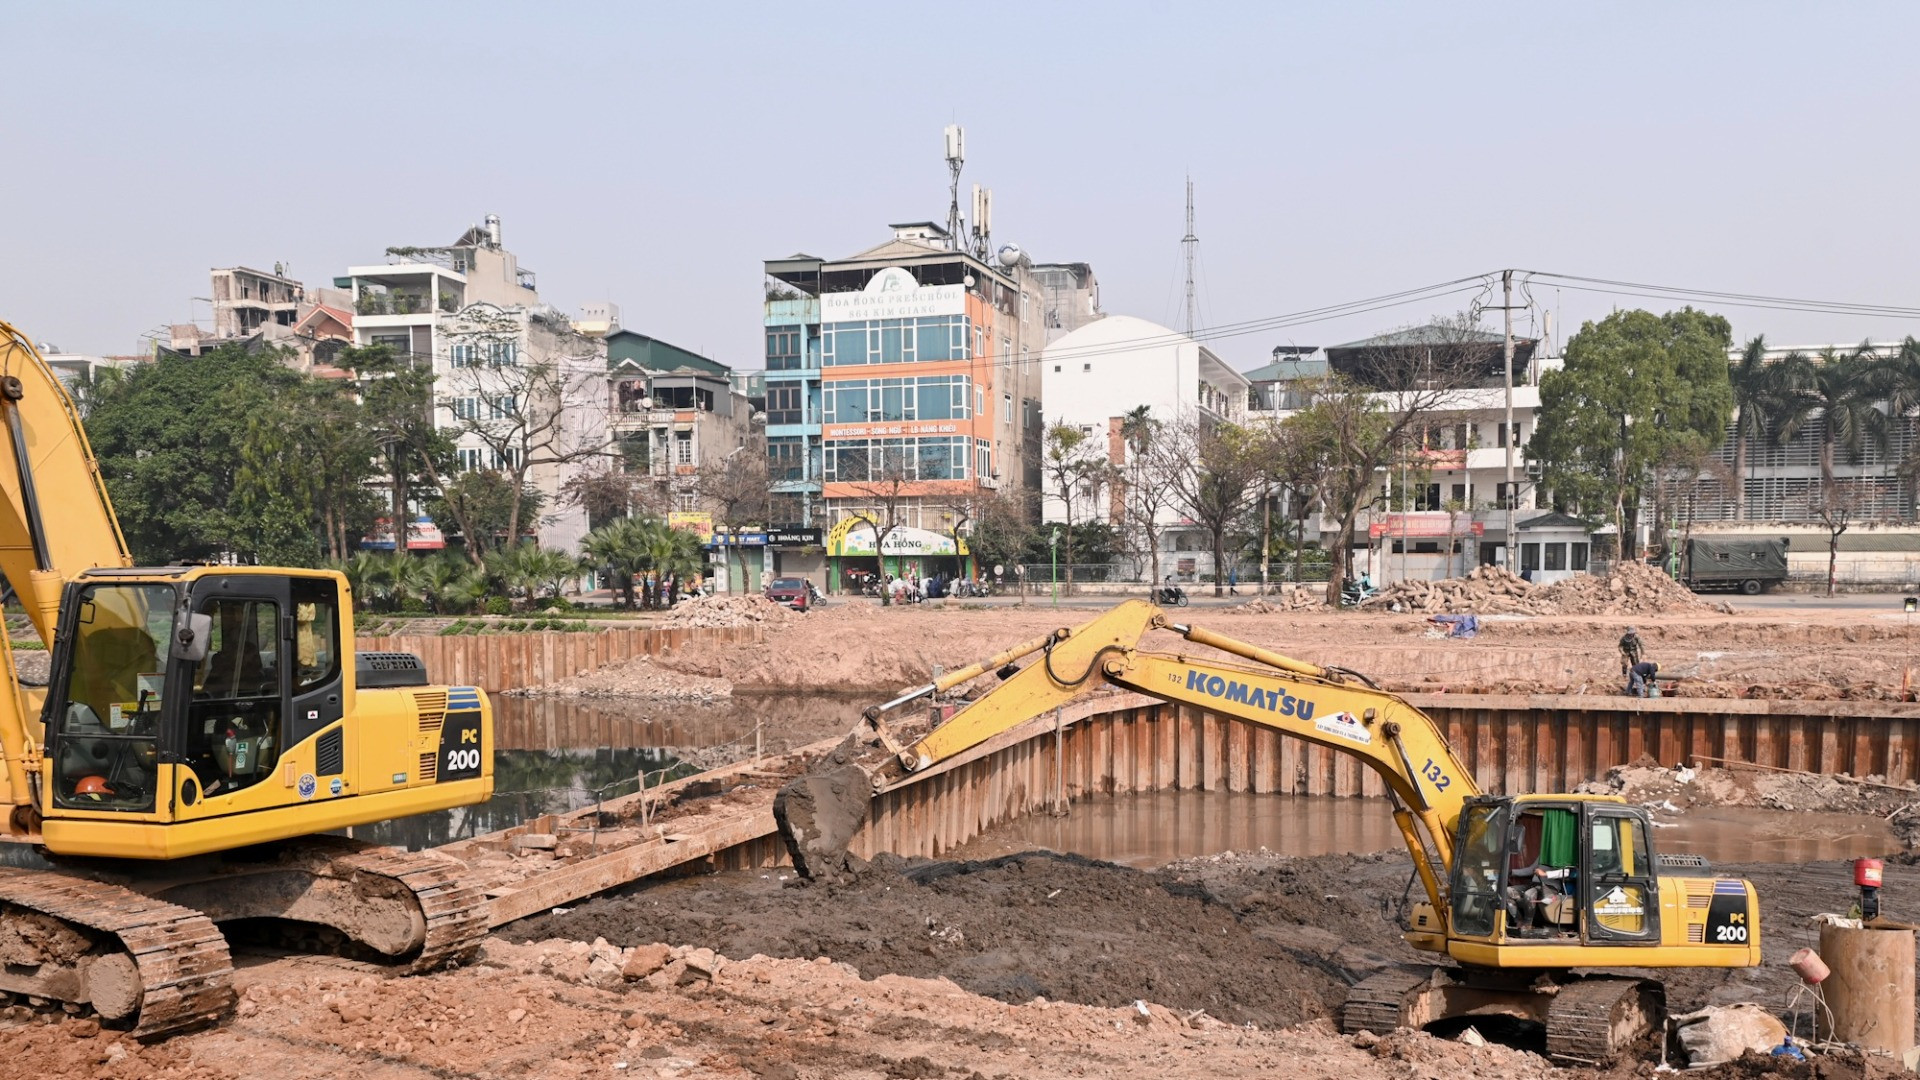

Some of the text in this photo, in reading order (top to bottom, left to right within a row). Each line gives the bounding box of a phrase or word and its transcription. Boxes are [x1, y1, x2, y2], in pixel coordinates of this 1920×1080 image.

[873, 308, 895, 316] KIM
[899, 305, 935, 315] GIANG
[830, 428, 866, 436] MONTESSORI
[1167, 670, 1314, 720] 132 KOMATSU
[461, 728, 477, 744] PC
[447, 749, 480, 770] 200
[1422, 758, 1450, 792] 132
[1729, 912, 1745, 924] PC
[1716, 925, 1747, 941] 200
